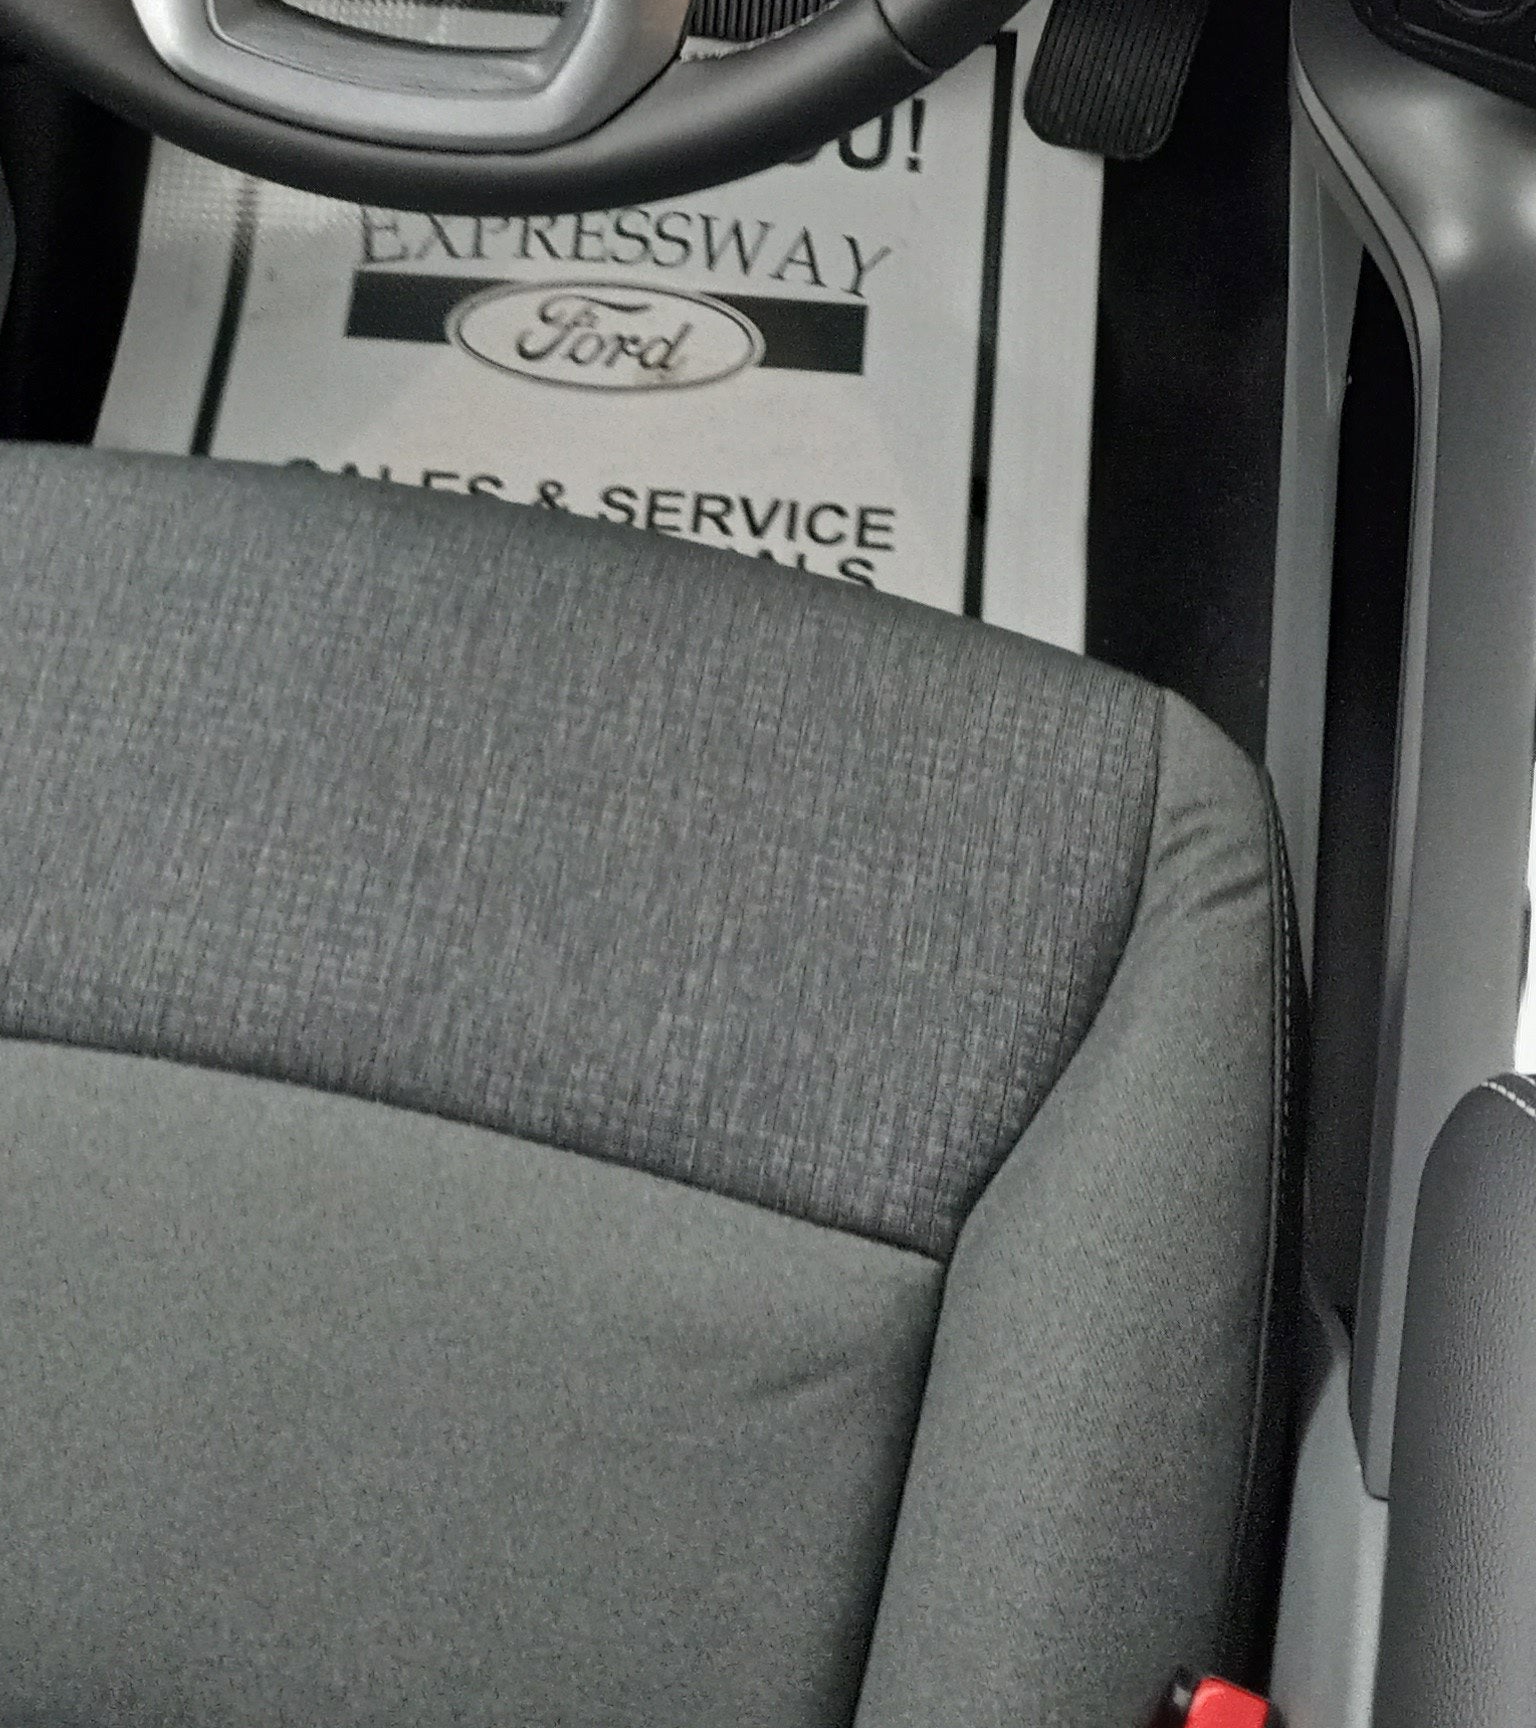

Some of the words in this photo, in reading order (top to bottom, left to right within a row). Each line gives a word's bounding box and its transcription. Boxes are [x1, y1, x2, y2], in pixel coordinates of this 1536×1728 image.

[360, 204, 893, 300] EXPRESSWAY
[515, 293, 695, 373] Ford
[598, 481, 897, 553] SERVICE
